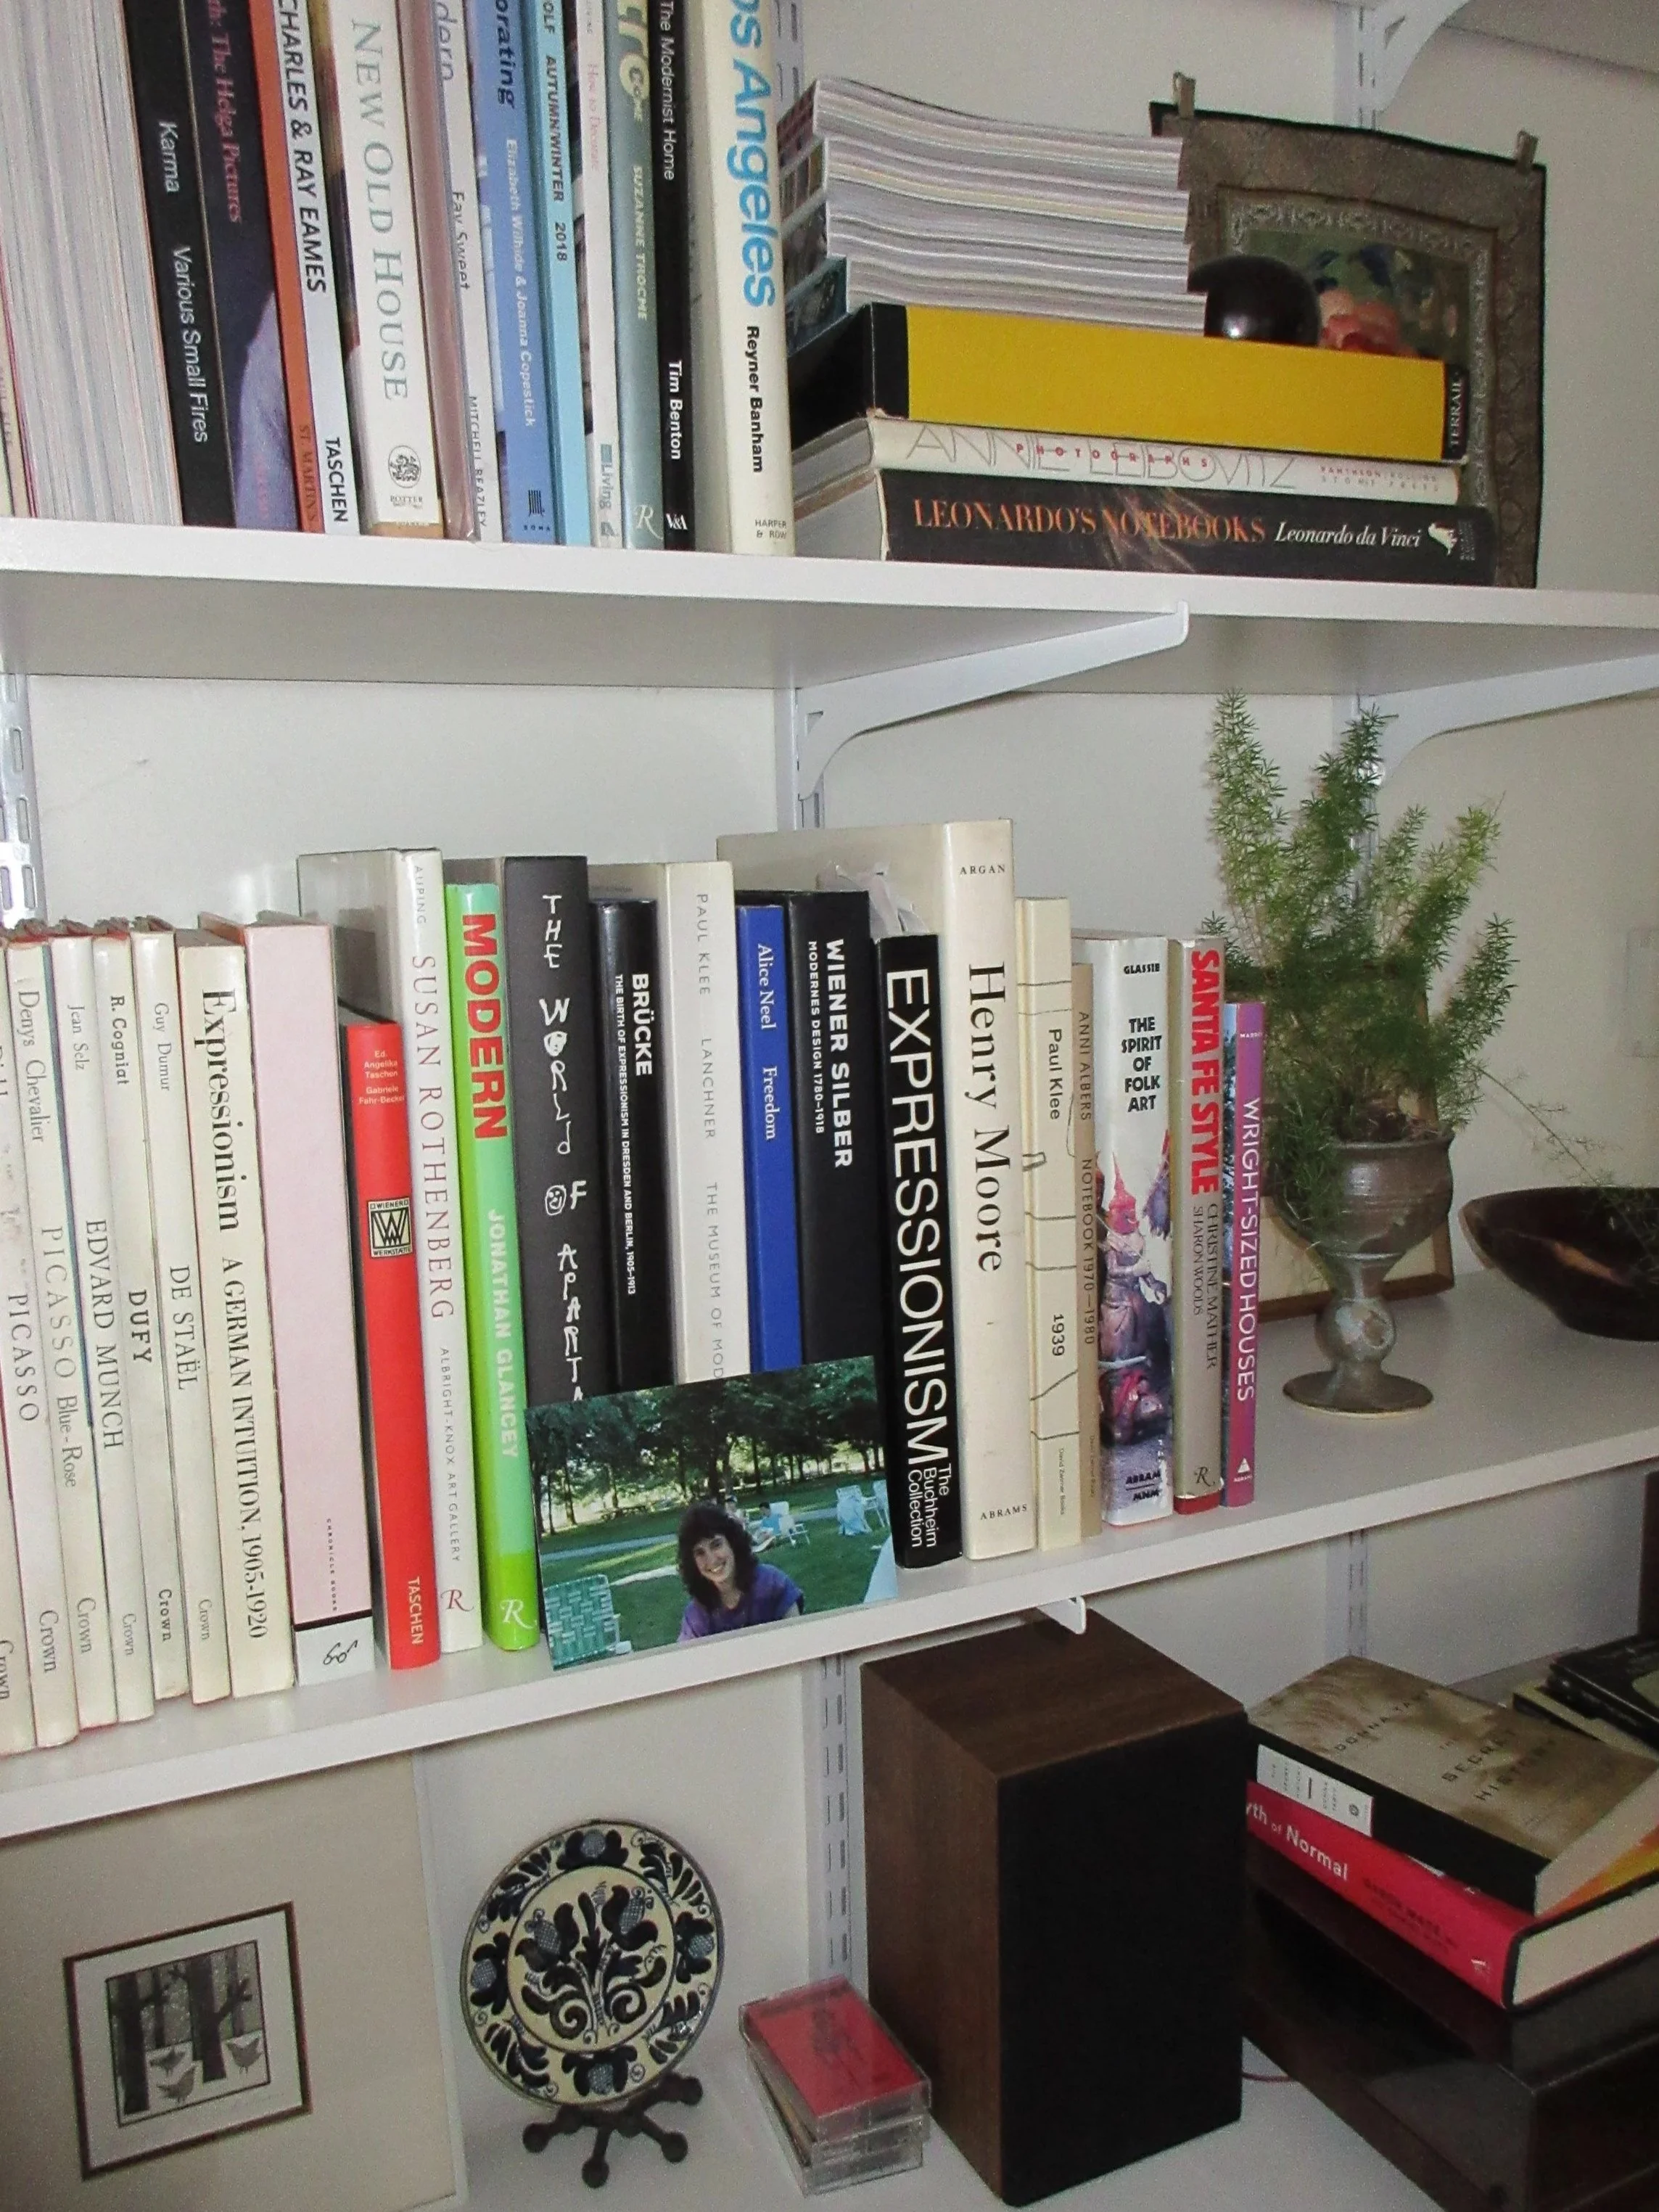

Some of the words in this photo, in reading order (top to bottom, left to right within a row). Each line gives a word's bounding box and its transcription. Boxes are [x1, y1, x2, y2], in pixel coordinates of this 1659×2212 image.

[659, 1, 675, 31] The
[351, 18, 387, 128] NEW
[661, 36, 676, 126] Modernist
[158, 118, 180, 194] Karma
[291, 119, 311, 141] &
[545, 55, 565, 202] AUTUMN/WINTER
[663, 129, 678, 181] Home
[294, 149, 319, 201] RAY
[364, 140, 394, 236] OLD
[727, 58, 778, 308] Angeles
[299, 205, 327, 293] EAMES
[554, 222, 567, 262] 2018
[172, 246, 196, 325] Various
[516, 276, 527, 288] &
[373, 250, 408, 401] HOUSE
[516, 291, 530, 347] Joanna
[181, 329, 207, 389] Small
[669, 361, 683, 393] Tim
[745, 325, 760, 392] Reyner
[519, 350, 538, 427] Copestick
[189, 392, 208, 443] Fires
[669, 399, 684, 461] Benton
[749, 396, 764, 473] Banham
[325, 437, 349, 523] TASCHEN
[390, 494, 423, 503] POTTER
[599, 464, 615, 509] Living
[666, 512, 688, 531] V&A
[755, 518, 787, 529] HARPER
[769, 530, 787, 539] ROW
[913, 497, 1097, 535] LEONARDO'S
[1101, 508, 1266, 544] NOTEBOOKS
[1274, 521, 1354, 545] Leonardo
[1356, 524, 1377, 546] da
[1380, 526, 1423, 548] Vinci
[960, 864, 1006, 876] ARGAN
[541, 895, 564, 969] THE
[696, 893, 709, 942] PAUL
[614, 974, 625, 995] THE
[699, 952, 711, 995] KLEE
[758, 944, 774, 987] Alice
[808, 941, 820, 1016] MODERNES
[1124, 963, 1161, 974] GLASSIE
[17, 990, 41, 1047] Denys
[67, 1004, 86, 1034] Jean
[110, 995, 125, 1013] R.
[152, 1002, 170, 1033] Guy
[412, 955, 441, 1066] SUSAN
[616, 996, 625, 1027] BIRTH
[760, 990, 777, 1030] Neel
[826, 939, 849, 1052] WIENER
[1191, 949, 1220, 1055] SANTA
[112, 1017, 130, 1085] Cogniat
[462, 913, 508, 1139] MODERN
[617, 1029, 626, 1044] OF
[632, 973, 655, 1076] BRÜCKE
[812, 1019, 823, 1069] DESIGN
[964, 961, 1006, 1110] Henry
[1048, 1028, 1063, 1072] Paul
[1078, 1011, 1091, 1054] ANNI
[1121, 1035, 1162, 1053] SPIRIT
[1128, 1016, 1156, 1034] THE
[73, 1042, 91, 1071] Selz
[157, 1042, 172, 1092] Dumur
[363, 1061, 398, 1070] Angelika
[365, 1070, 398, 1079] Taschen
[374, 1050, 388, 1058] Ed.
[1133, 1056, 1152, 1072] OF
[1191, 1058, 1220, 1096] FE
[25, 1059, 50, 1142] Chevalier
[194, 988, 247, 1233] Expressionism
[618, 1045, 630, 1127] EXPRESSIONISM
[701, 1037, 717, 1139] LANCHNER
[762, 1065, 780, 1140] Freedom
[1049, 1077, 1063, 1120] Klee
[1079, 1061, 1092, 1122] ALBERS
[1124, 1074, 1161, 1093] FOLK
[1127, 1095, 1157, 1113] ART
[621, 1127, 630, 1139] IN
[831, 1062, 853, 1168] SILBER
[621, 1140, 632, 1188] DRESDEN
[1190, 1101, 1220, 1196] STYLE
[376, 1200, 405, 1209] WIENER
[419, 1086, 455, 1319] ROTHENBERG
[623, 1188, 633, 1210] AND
[707, 1181, 718, 1216] THE
[886, 969, 949, 1465] EXPRESSIONISM
[974, 1124, 1010, 1272] Moore
[1082, 1159, 1093, 1250] NOTEBOOK
[1239, 1097, 1261, 1288] WRIGHT-SIZED
[624, 1212, 634, 1250] BERLIN,
[1206, 1202, 1219, 1294] CHRISTINE
[86, 1219, 115, 1329] EDVARD
[170, 1265, 192, 1301] DE
[222, 1257, 244, 1275] A
[487, 1208, 512, 1339] JONATHAN
[707, 1225, 722, 1299] MUSEUM
[41, 1226, 77, 1378] PICASSO
[128, 1288, 152, 1363] DUFY
[711, 1307, 723, 1328] OF
[8, 1293, 40, 1421] PICASSO
[173, 1312, 201, 1390] STAËL
[223, 1279, 252, 1388] GERMAN
[1052, 1313, 1065, 1357] 1939
[1237, 1294, 1258, 1402] HOUSES
[96, 1344, 124, 1450] MUNCH
[440, 1347, 456, 1465] ALBRIGHT-KNOX
[496, 1348, 519, 1458] GLANCEY
[232, 1394, 262, 1531] INTUITION,
[447, 1473, 458, 1498] ART
[939, 1463, 952, 1496] The
[448, 1502, 461, 1562] GALLERY
[908, 1469, 925, 1547] Collection
[923, 1466, 939, 1547] Buchheim
[980, 1503, 1028, 1521] ABRAMS
[242, 1533, 269, 1639] 1905-1920
[408, 1576, 424, 1645] TASCHEN
[440, 1589, 474, 1612] R
[499, 1598, 534, 1629] R
[39, 1609, 59, 1674] Crown
[77, 1596, 96, 1654] Crown
[122, 1613, 137, 1656] Crown
[158, 1588, 173, 1642] Crown
[198, 1598, 213, 1641] Crown
[1271, 1822, 1283, 1835] of
[1285, 1824, 1349, 1882] Normal
